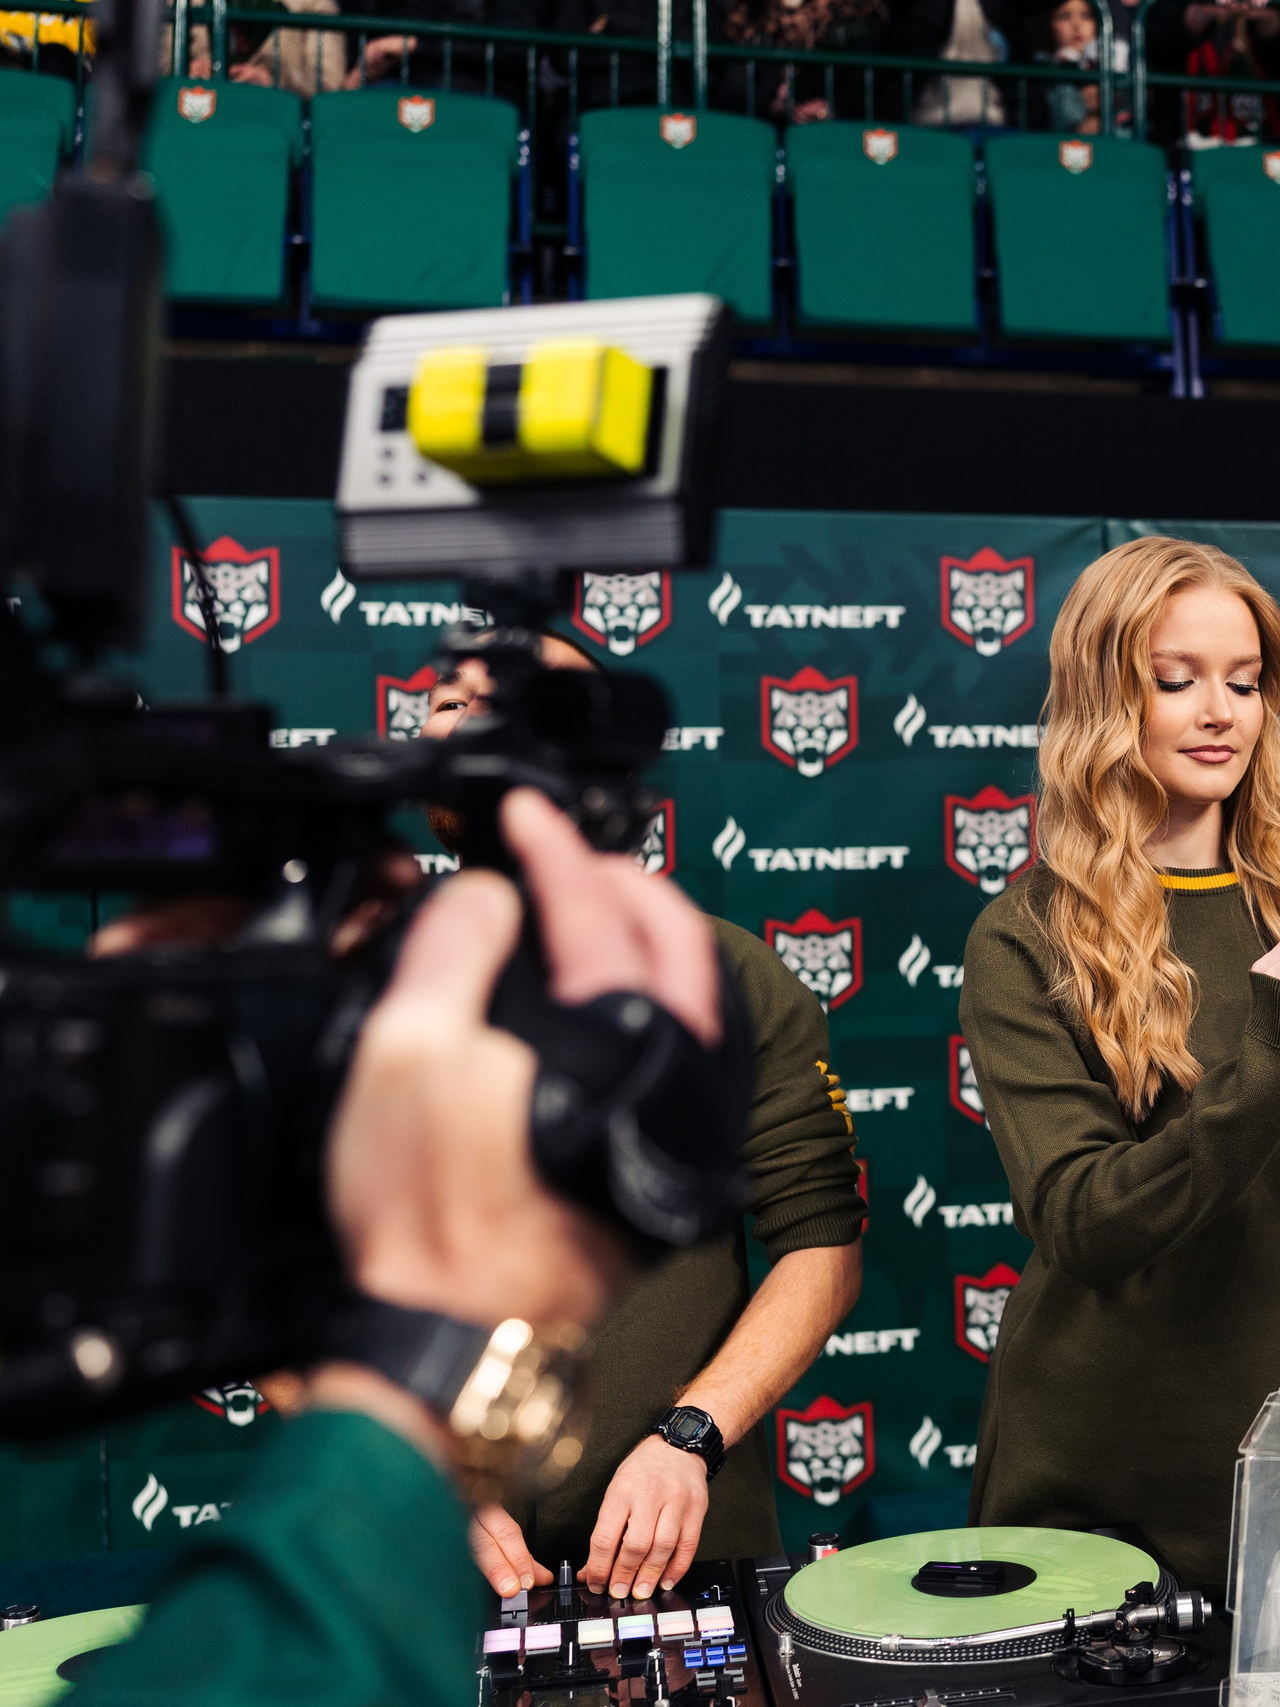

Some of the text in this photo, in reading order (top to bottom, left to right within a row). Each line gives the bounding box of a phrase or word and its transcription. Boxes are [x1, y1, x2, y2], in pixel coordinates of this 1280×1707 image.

[359, 602, 494, 626] TATNE
[745, 605, 905, 628] TATNEFT
[928, 724, 1041, 748] TATNE
[748, 846, 910, 872] TATNEFT
[825, 1328, 920, 1356] NEFT
